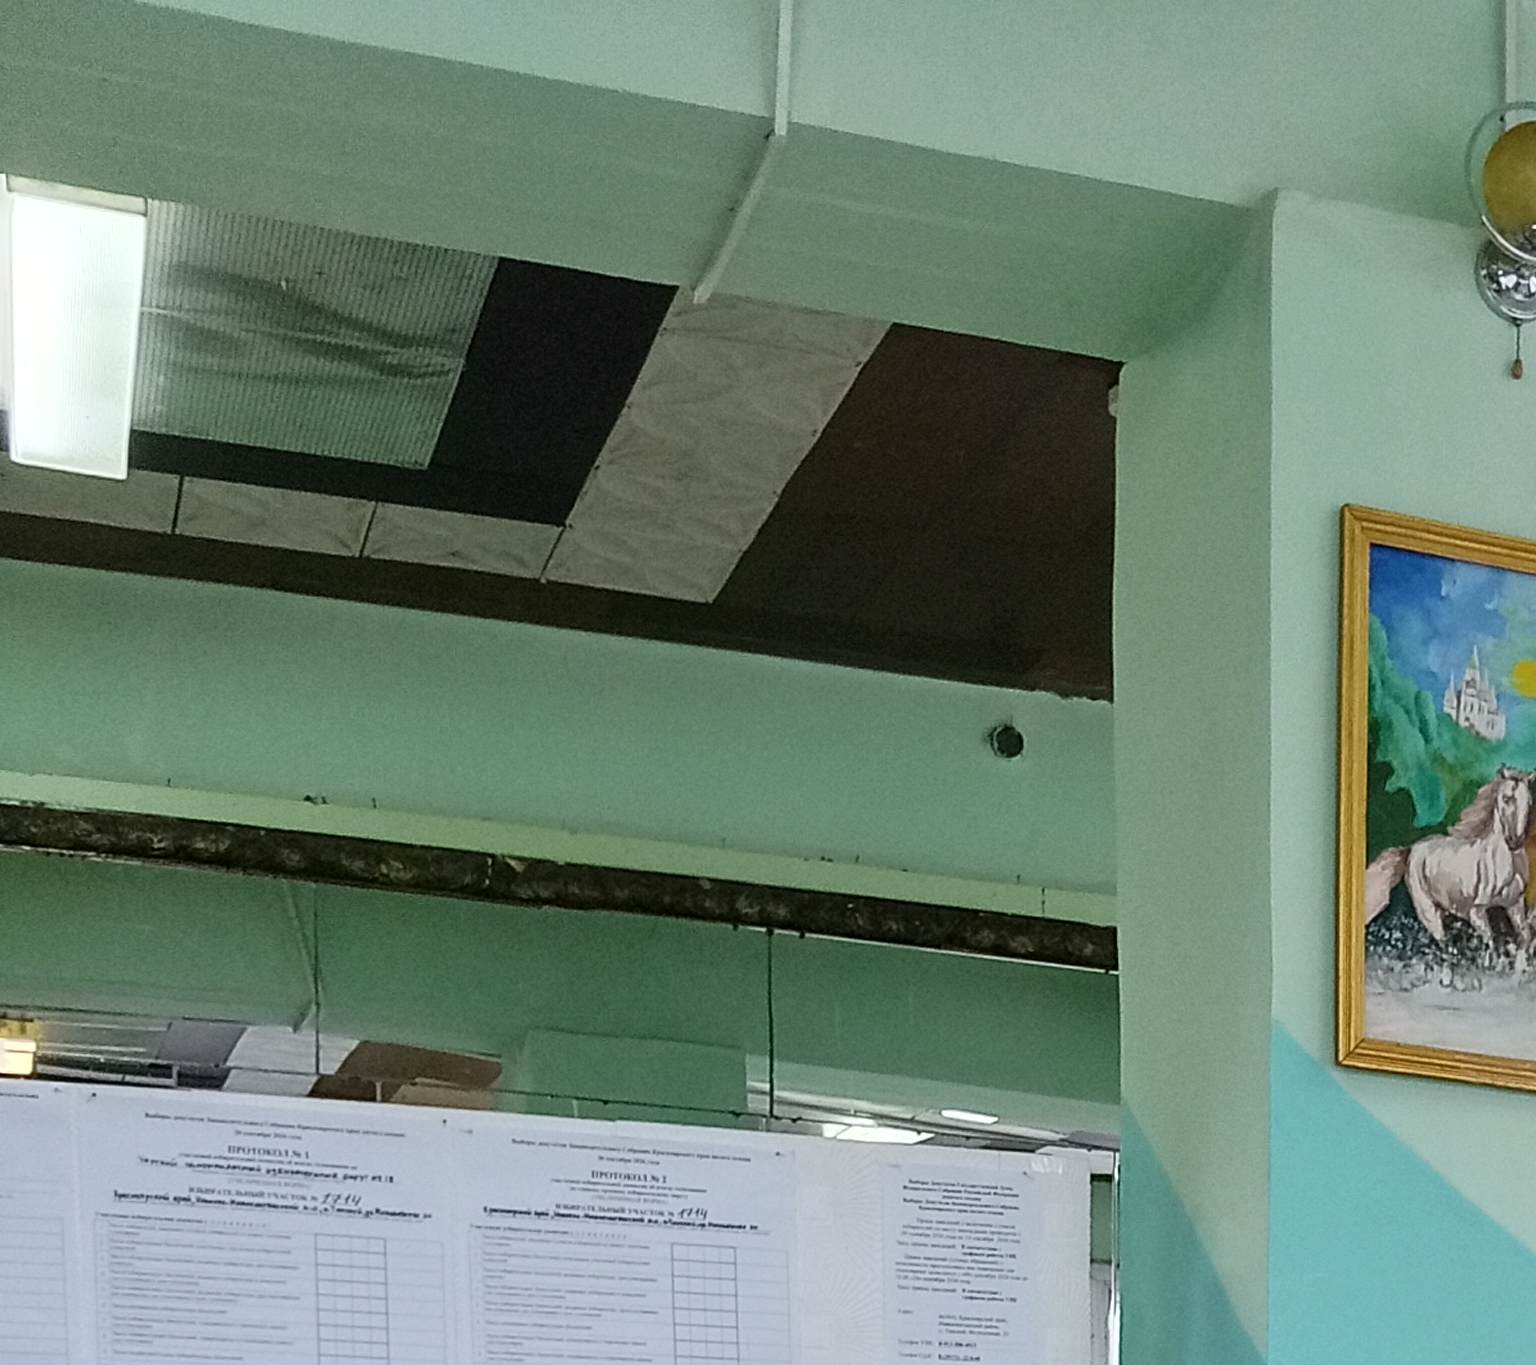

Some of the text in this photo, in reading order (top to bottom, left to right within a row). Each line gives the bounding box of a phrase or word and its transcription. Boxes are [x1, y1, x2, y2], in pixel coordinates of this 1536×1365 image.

[228, 1145, 288, 1157] ПРОТОКОЛ
[591, 1170, 647, 1182] ПРОТОКОЛ
[322, 1192, 361, 1206] 1714
[678, 1208, 708, 1219] 1714
